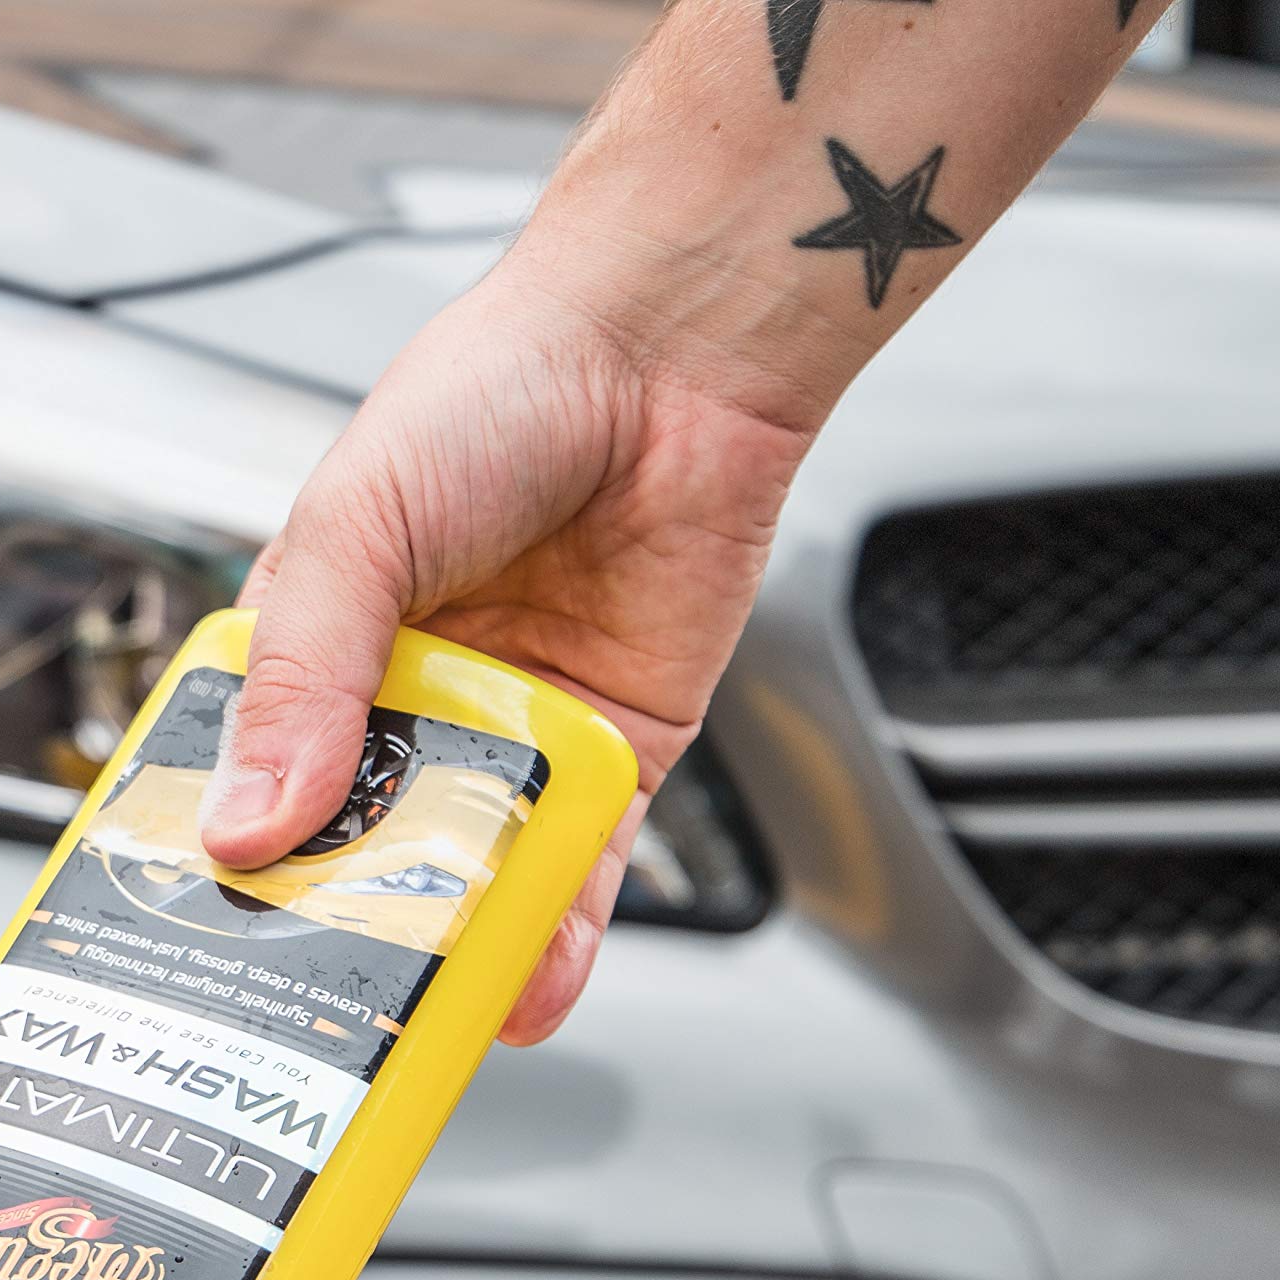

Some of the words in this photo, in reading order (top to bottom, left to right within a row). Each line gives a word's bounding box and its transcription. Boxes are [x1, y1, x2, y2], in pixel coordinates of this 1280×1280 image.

[54, 913, 99, 935] shine
[97, 927, 189, 961] just-waxed
[80, 943, 170, 979] technology
[188, 948, 246, 975] glossy,
[169, 972, 238, 999] polymer
[247, 965, 292, 991] deep,
[292, 983, 307, 995] a
[24, 985, 133, 1022] Difference!
[235, 989, 313, 1027] Synthetic
[307, 986, 372, 1024] Leaves
[139, 1016, 173, 1035] the
[111, 1042, 140, 1062] &
[179, 1029, 219, 1049] See
[225, 1043, 265, 1065] Can
[273, 1061, 312, 1086] You
[133, 1049, 328, 1150] WASH
